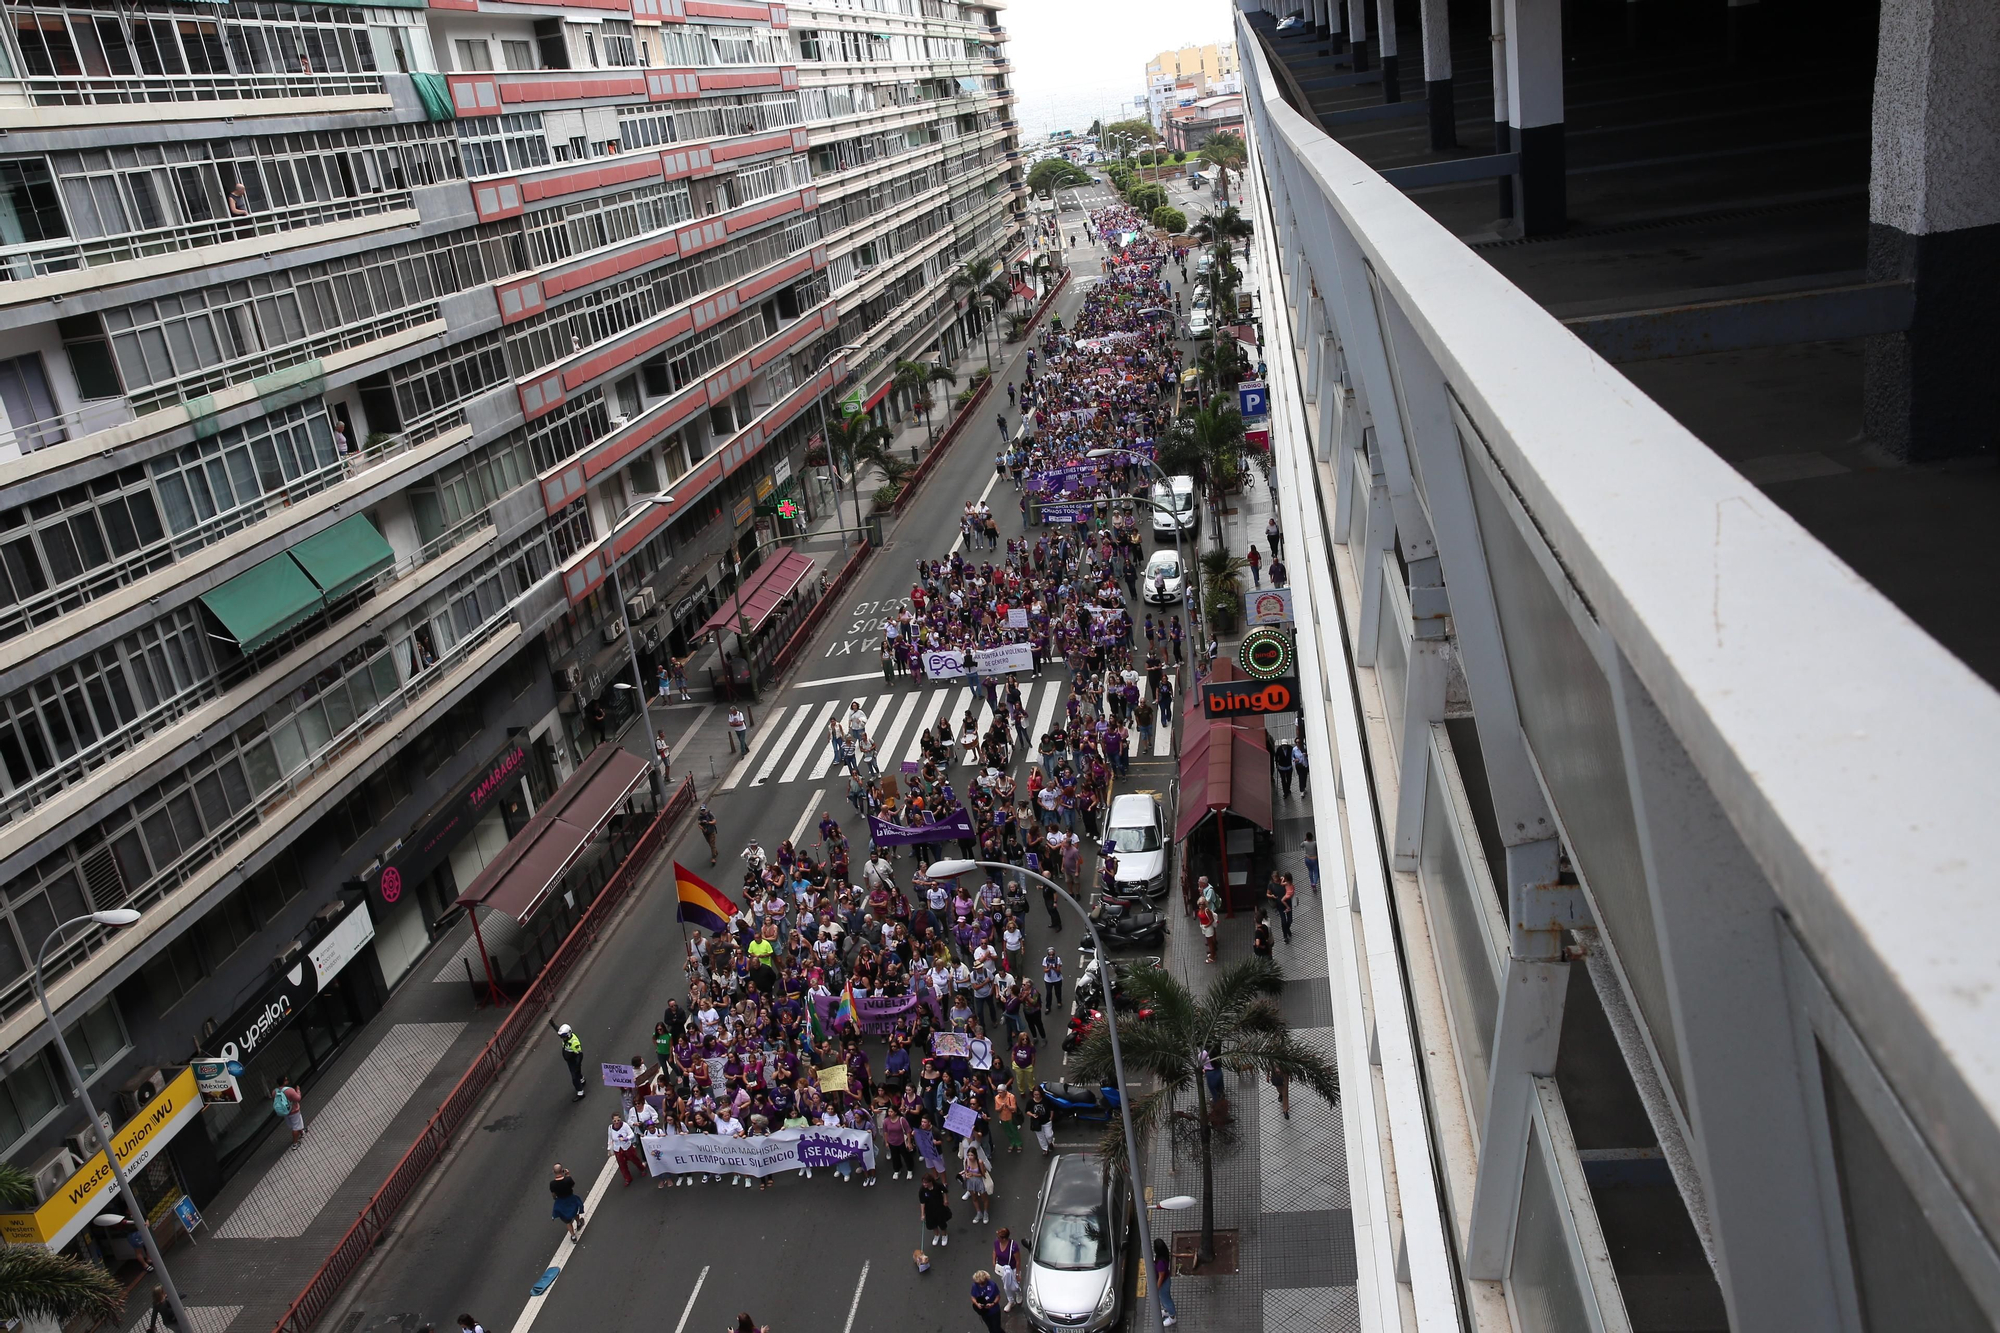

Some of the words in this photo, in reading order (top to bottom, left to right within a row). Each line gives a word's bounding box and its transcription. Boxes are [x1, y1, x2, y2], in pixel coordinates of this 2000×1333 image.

[1246, 394, 1260, 412] P
[982, 652, 998, 660] CONTRA
[1005, 647, 1028, 655] VIOLENCIA
[991, 658, 1009, 666] GÉNERO
[470, 746, 524, 805] TAMARAGUA
[257, 1012, 286, 1043] COCINAS
[697, 1144, 737, 1155] VIOLENCIA
[738, 1143, 782, 1156] MACHISTA.
[804, 1146, 822, 1159] ¡SE
[675, 1156, 687, 1165] EL
[688, 1154, 726, 1166] TIEMPO
[727, 1157, 747, 1166] DEL
[749, 1150, 794, 1168] SILENCIO
[108, 1168, 128, 1194] BAZR
[128, 1150, 149, 1176] MEXICO
